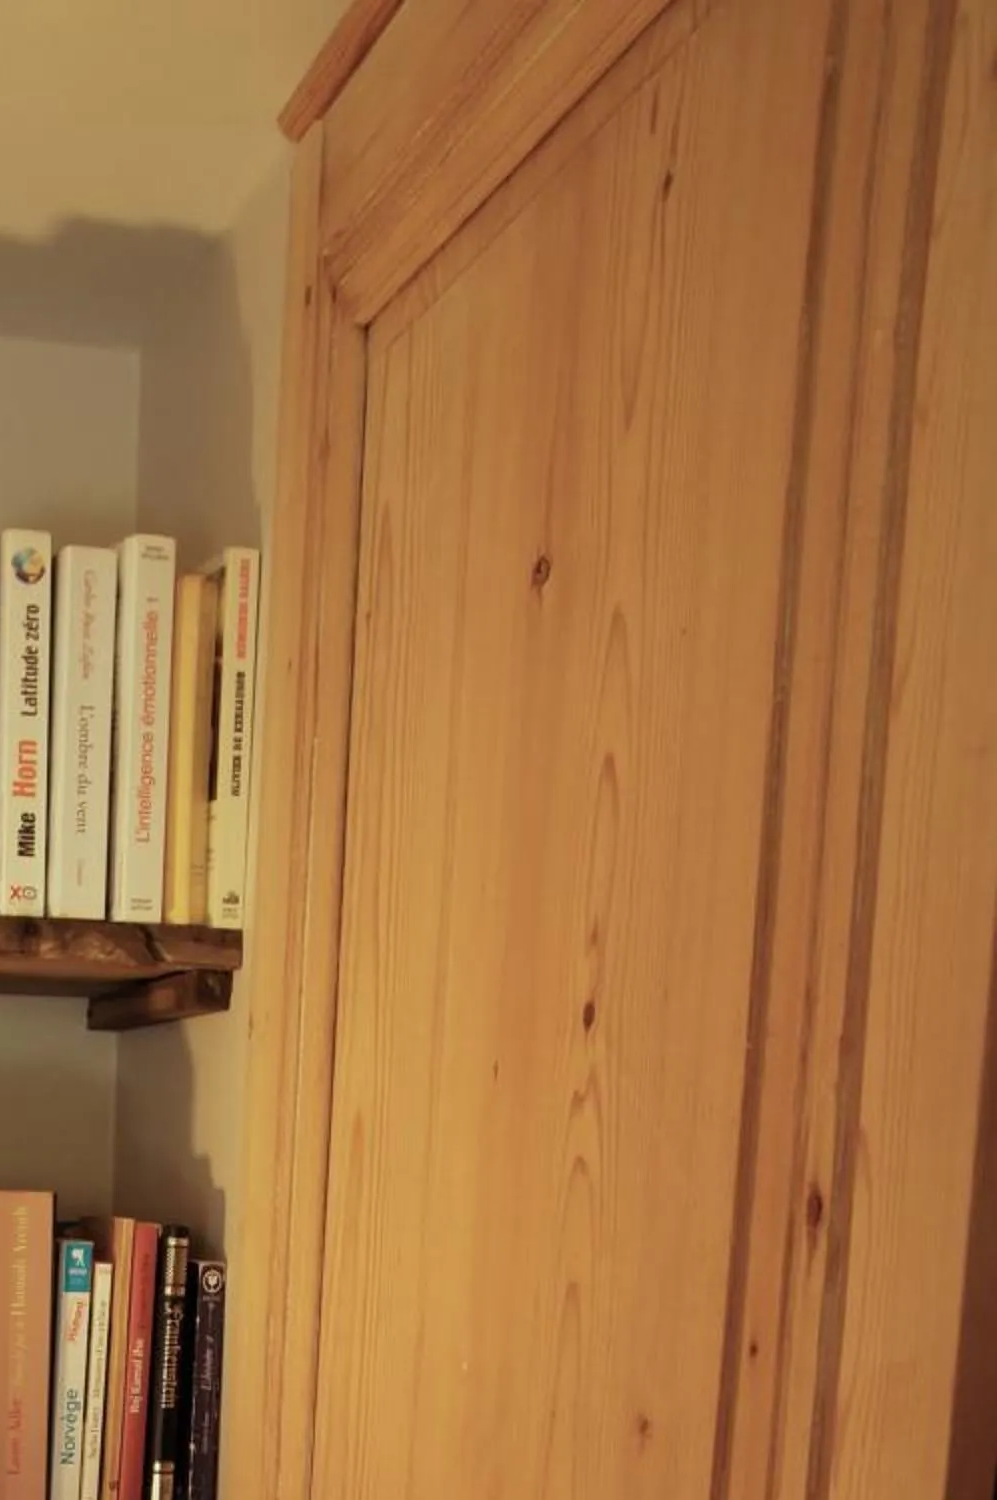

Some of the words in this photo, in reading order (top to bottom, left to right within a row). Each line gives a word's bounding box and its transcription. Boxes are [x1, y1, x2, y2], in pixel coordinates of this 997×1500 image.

[24, 603, 41, 641] zéro
[20, 641, 40, 717] Latitude
[139, 609, 160, 727] émotionnelle
[12, 739, 38, 799] Horn
[78, 703, 96, 769] L'ombre
[76, 773, 92, 795] du
[134, 730, 155, 843] L'intelligence
[16, 811, 37, 858] Mike
[161, 1300, 186, 1409] Frankenstein
[60, 1388, 81, 1465] Norvège
